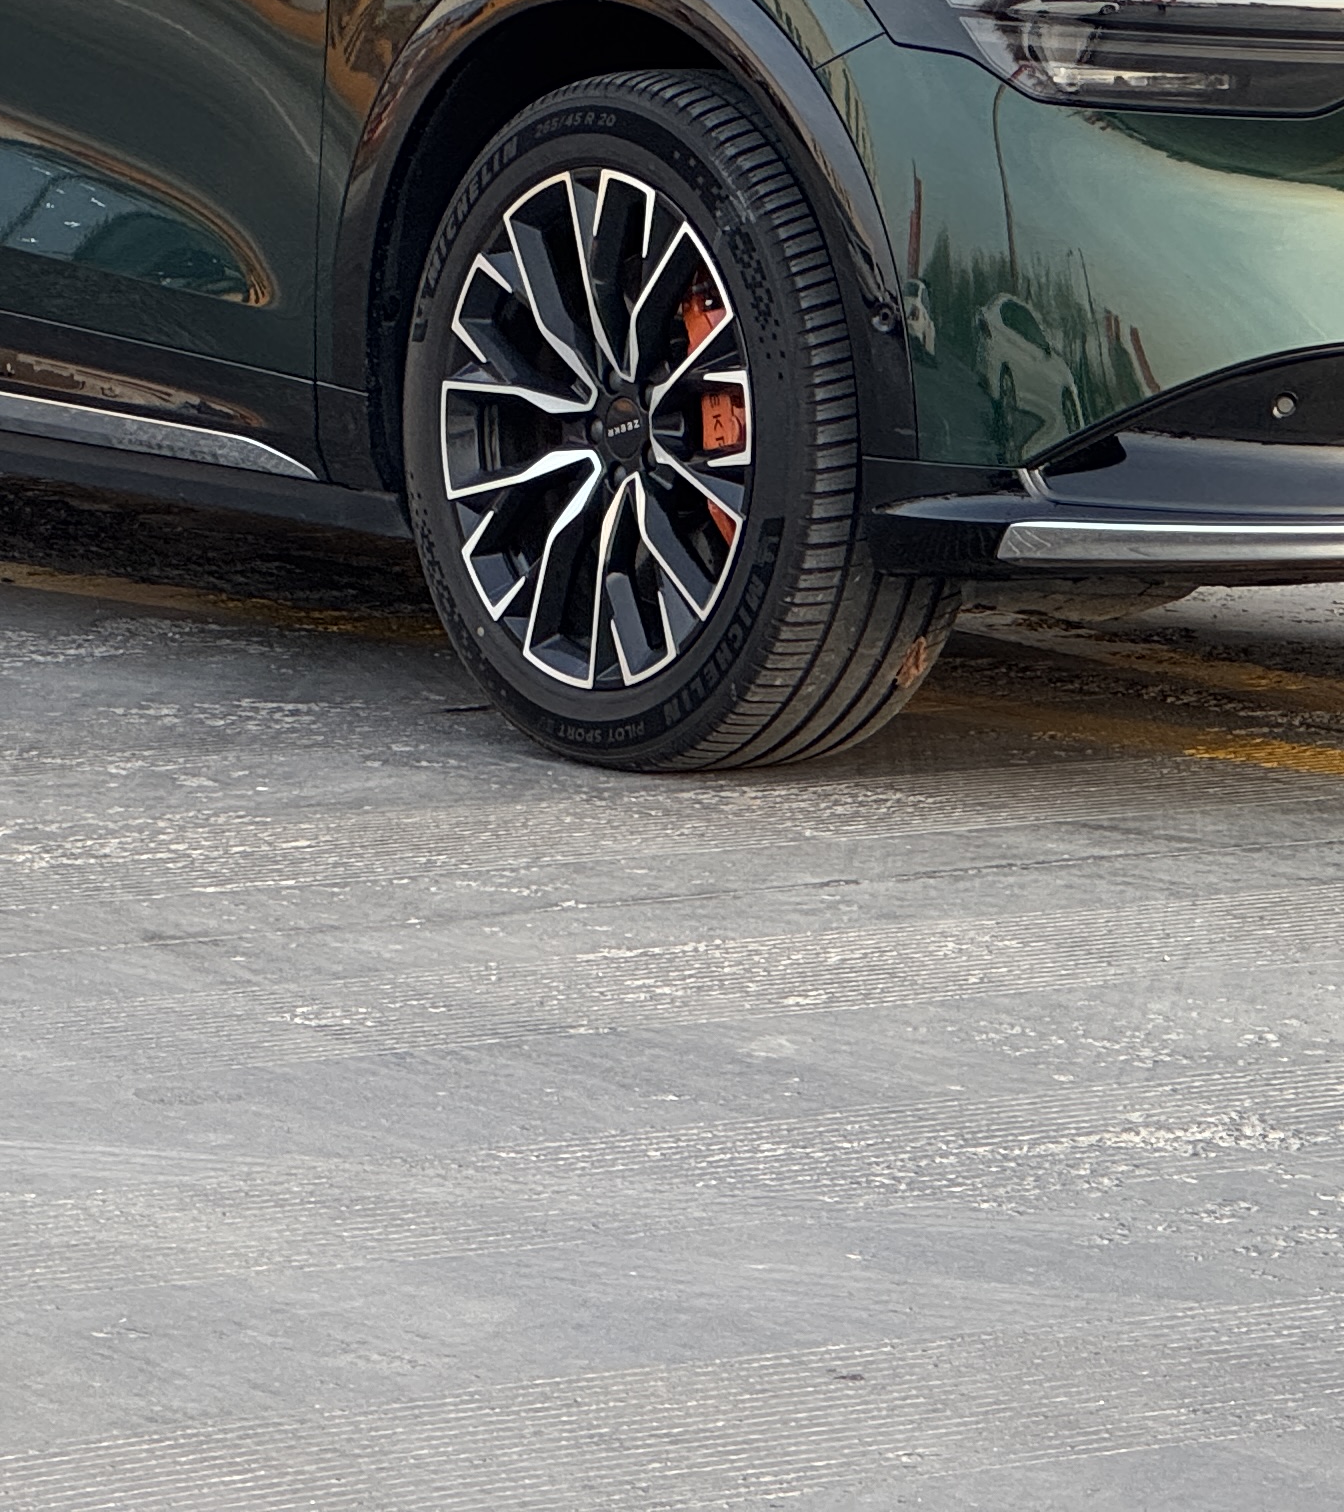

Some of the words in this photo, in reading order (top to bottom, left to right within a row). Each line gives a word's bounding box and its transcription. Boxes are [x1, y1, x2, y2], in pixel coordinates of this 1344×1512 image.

[598, 113, 616, 127] 20
[607, 419, 640, 437] ZEEKR
[557, 722, 602, 740] SPORT
[608, 720, 646, 738] PILOT
